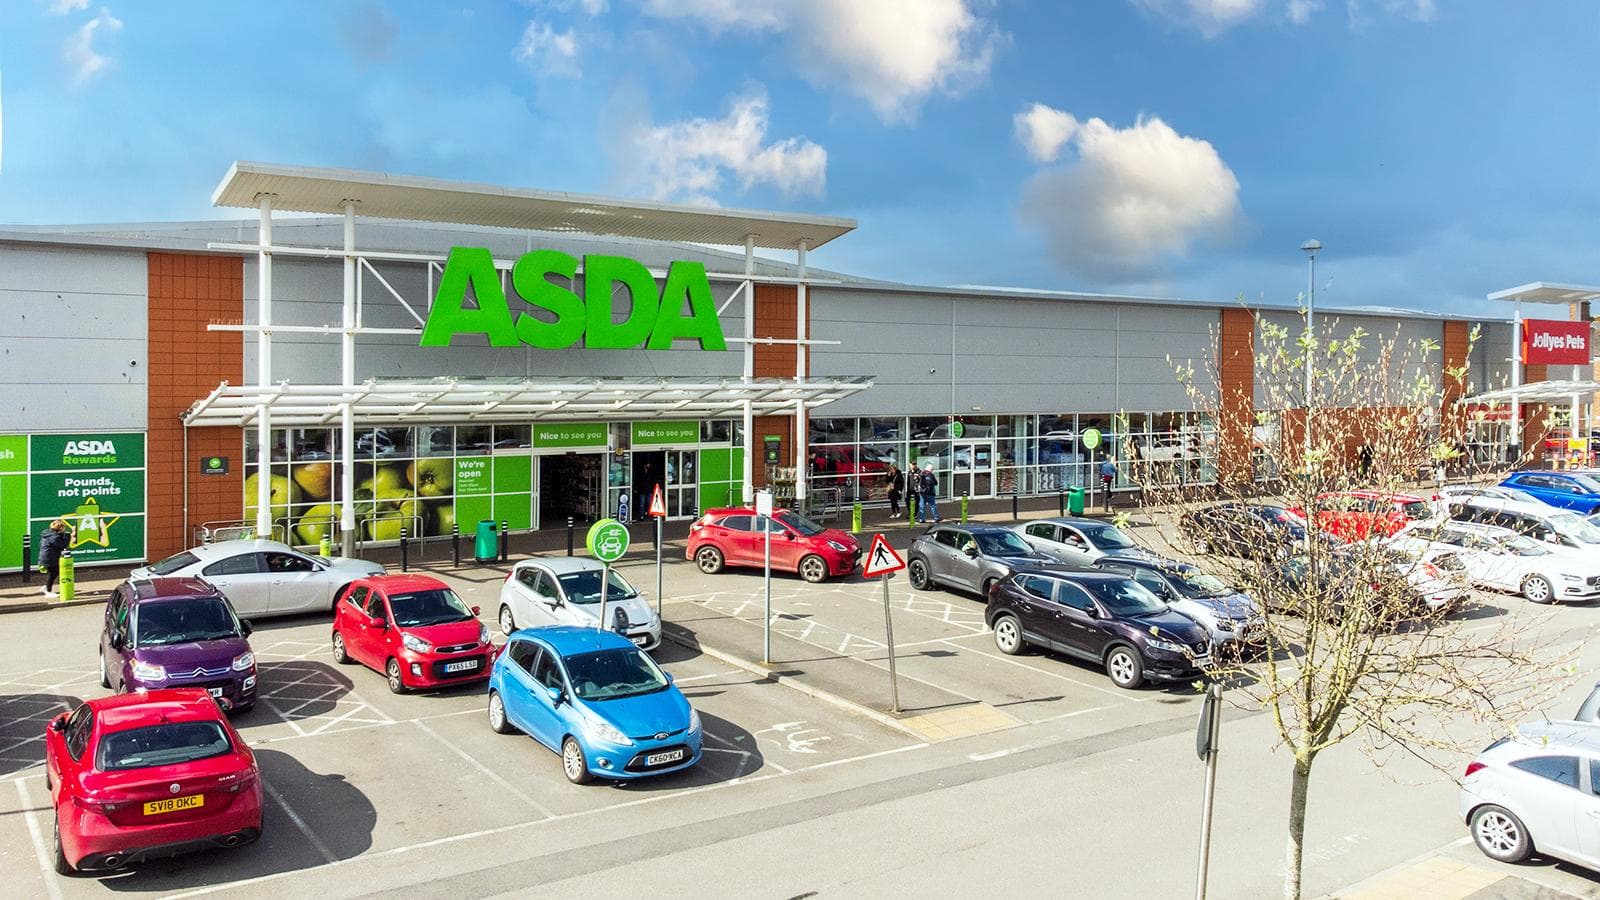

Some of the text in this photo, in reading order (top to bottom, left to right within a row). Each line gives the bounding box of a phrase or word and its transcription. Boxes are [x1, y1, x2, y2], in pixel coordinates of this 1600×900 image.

[420, 246, 727, 351] ASDA
[1532, 333, 1585, 351] Jollyes Pets
[540, 432, 559, 440] Nice
[586, 432, 601, 440] you
[63, 440, 116, 455] ASDA
[63, 455, 117, 465] Rewards
[458, 461, 485, 469] We're
[458, 471, 481, 479] open
[64, 477, 114, 488] Pounds,
[58, 487, 121, 497] not points
[150, 796, 197, 812] SV18 OKC
